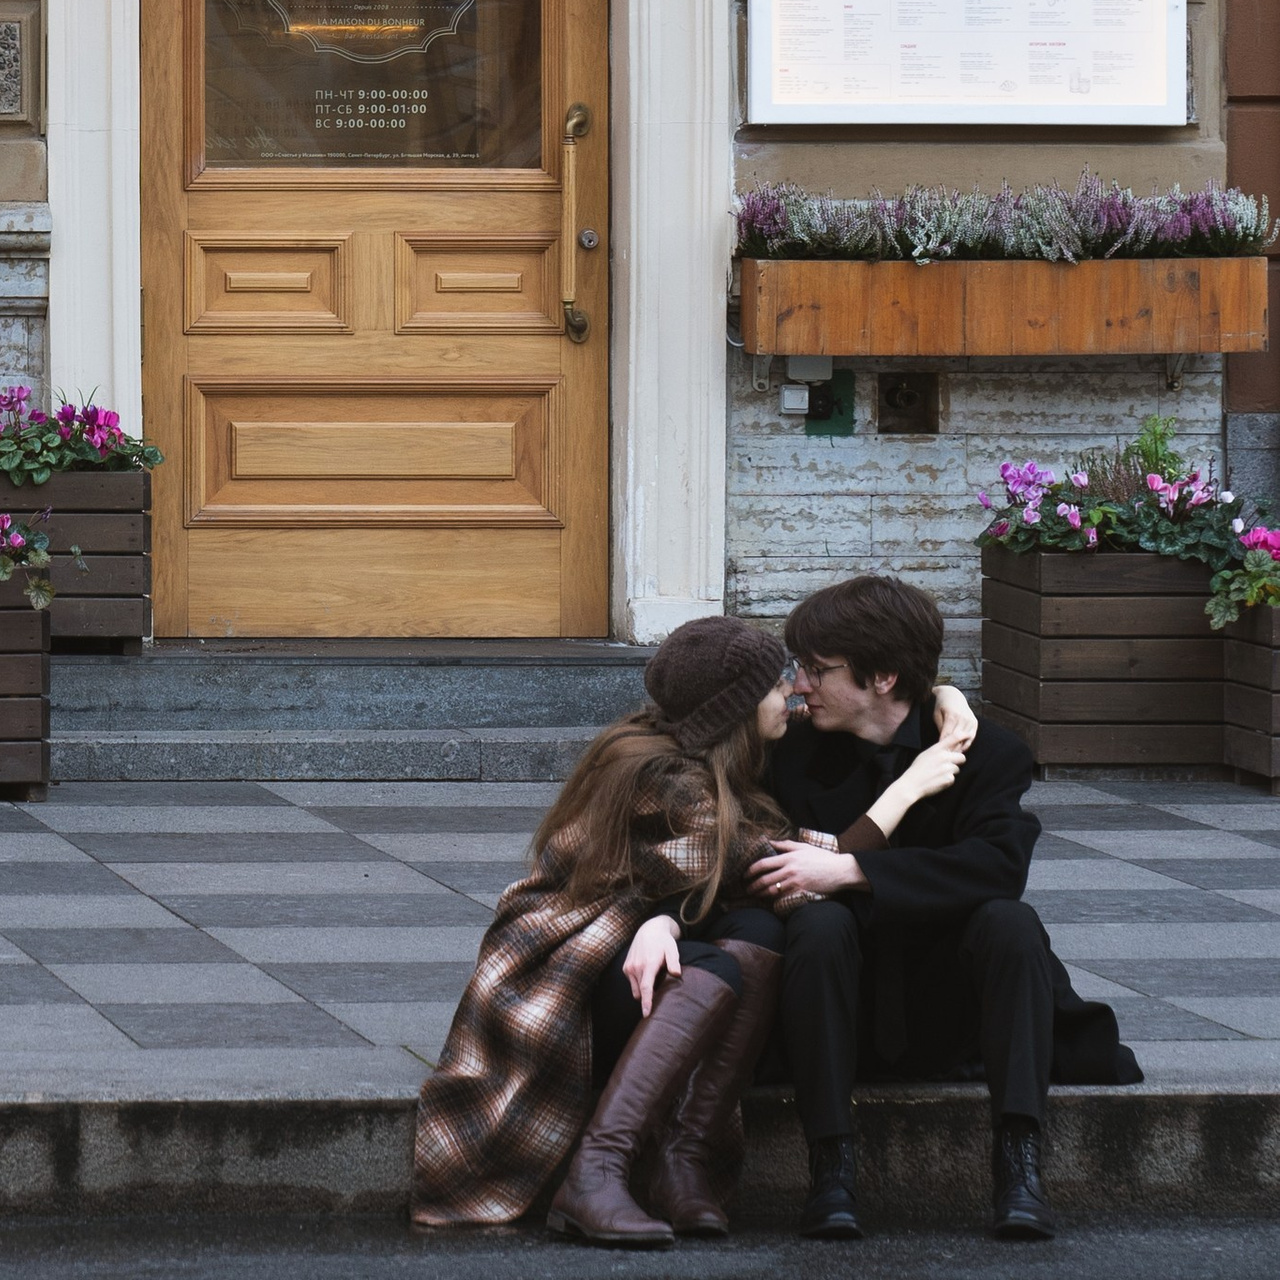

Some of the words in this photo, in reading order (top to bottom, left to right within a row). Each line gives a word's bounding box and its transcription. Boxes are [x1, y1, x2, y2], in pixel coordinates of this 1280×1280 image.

[317, 18, 328, 26] LA
[329, 18, 365, 26] MAISON
[367, 18, 380, 26] DU
[382, 18, 425, 26] BONHEUR
[315, 89, 354, 100] ПН-ЧТ
[358, 89, 428, 100] 9:00-00:00
[315, 104, 353, 114] ПТ-СБ
[358, 104, 427, 114] 9:00-01:00
[315, 118, 331, 129] ВС
[336, 118, 406, 129] 9:00-00:00
